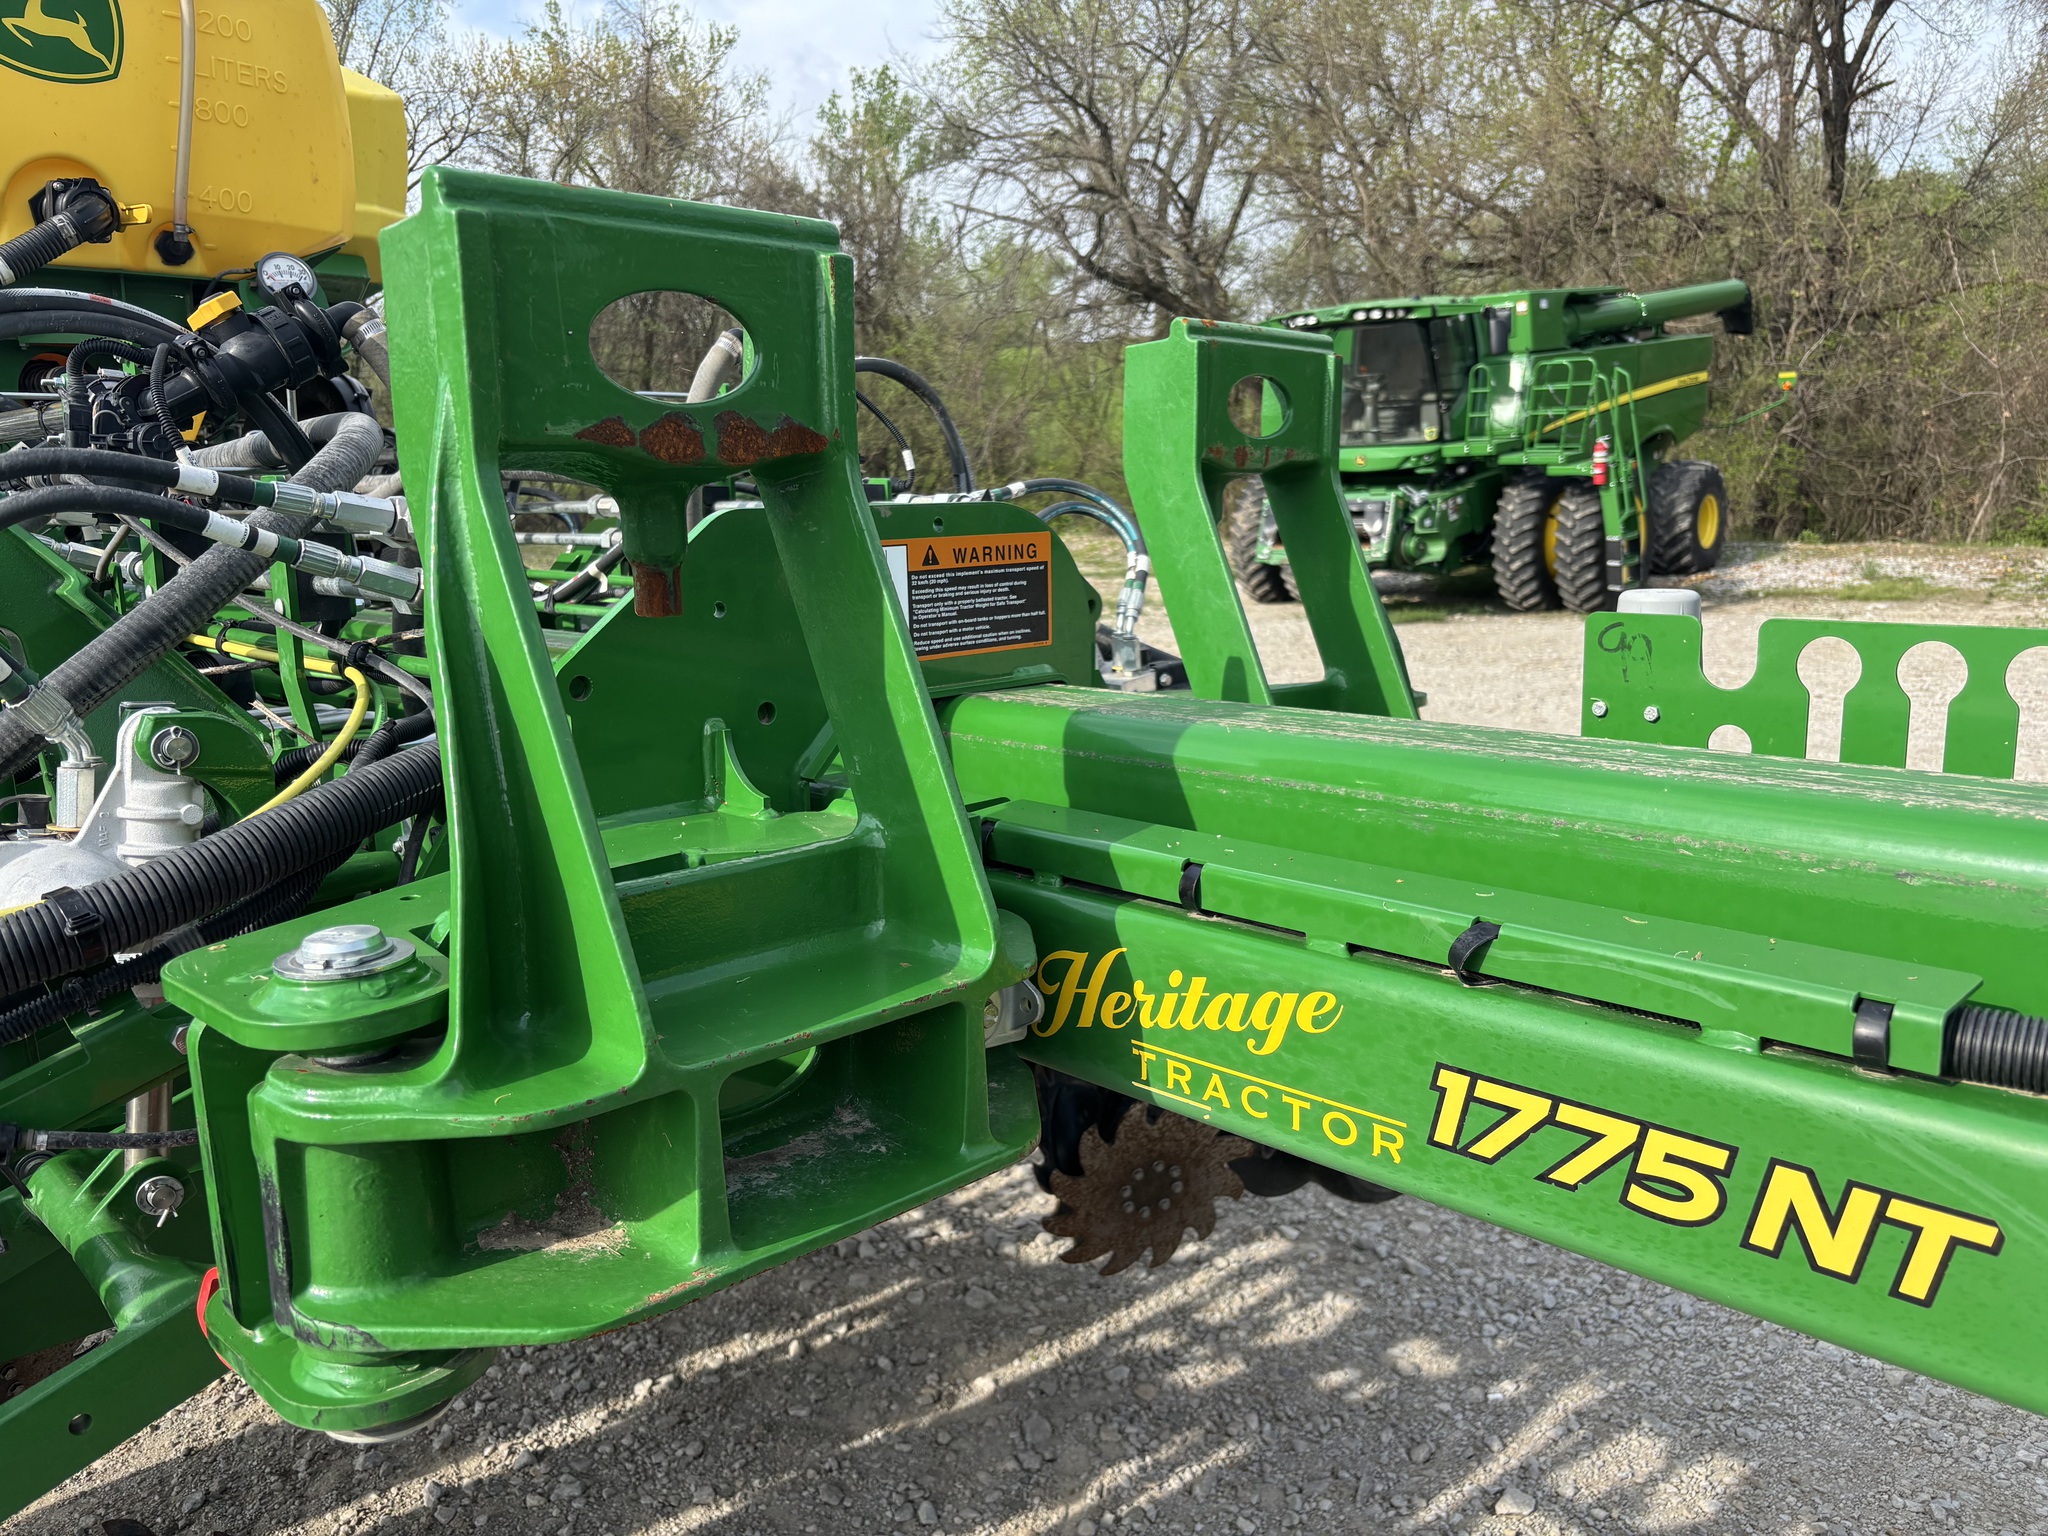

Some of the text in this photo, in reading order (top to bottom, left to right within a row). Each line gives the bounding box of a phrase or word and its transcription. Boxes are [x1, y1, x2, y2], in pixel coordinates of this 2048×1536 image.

[194, 97, 249, 127] 800
[199, 185, 252, 213] 400
[952, 543, 1038, 564] WARNING
[1032, 947, 1343, 1056] Heritage
[1132, 1047, 1405, 1164] TRACTOR
[1429, 1063, 2003, 1307] 1775 NT
